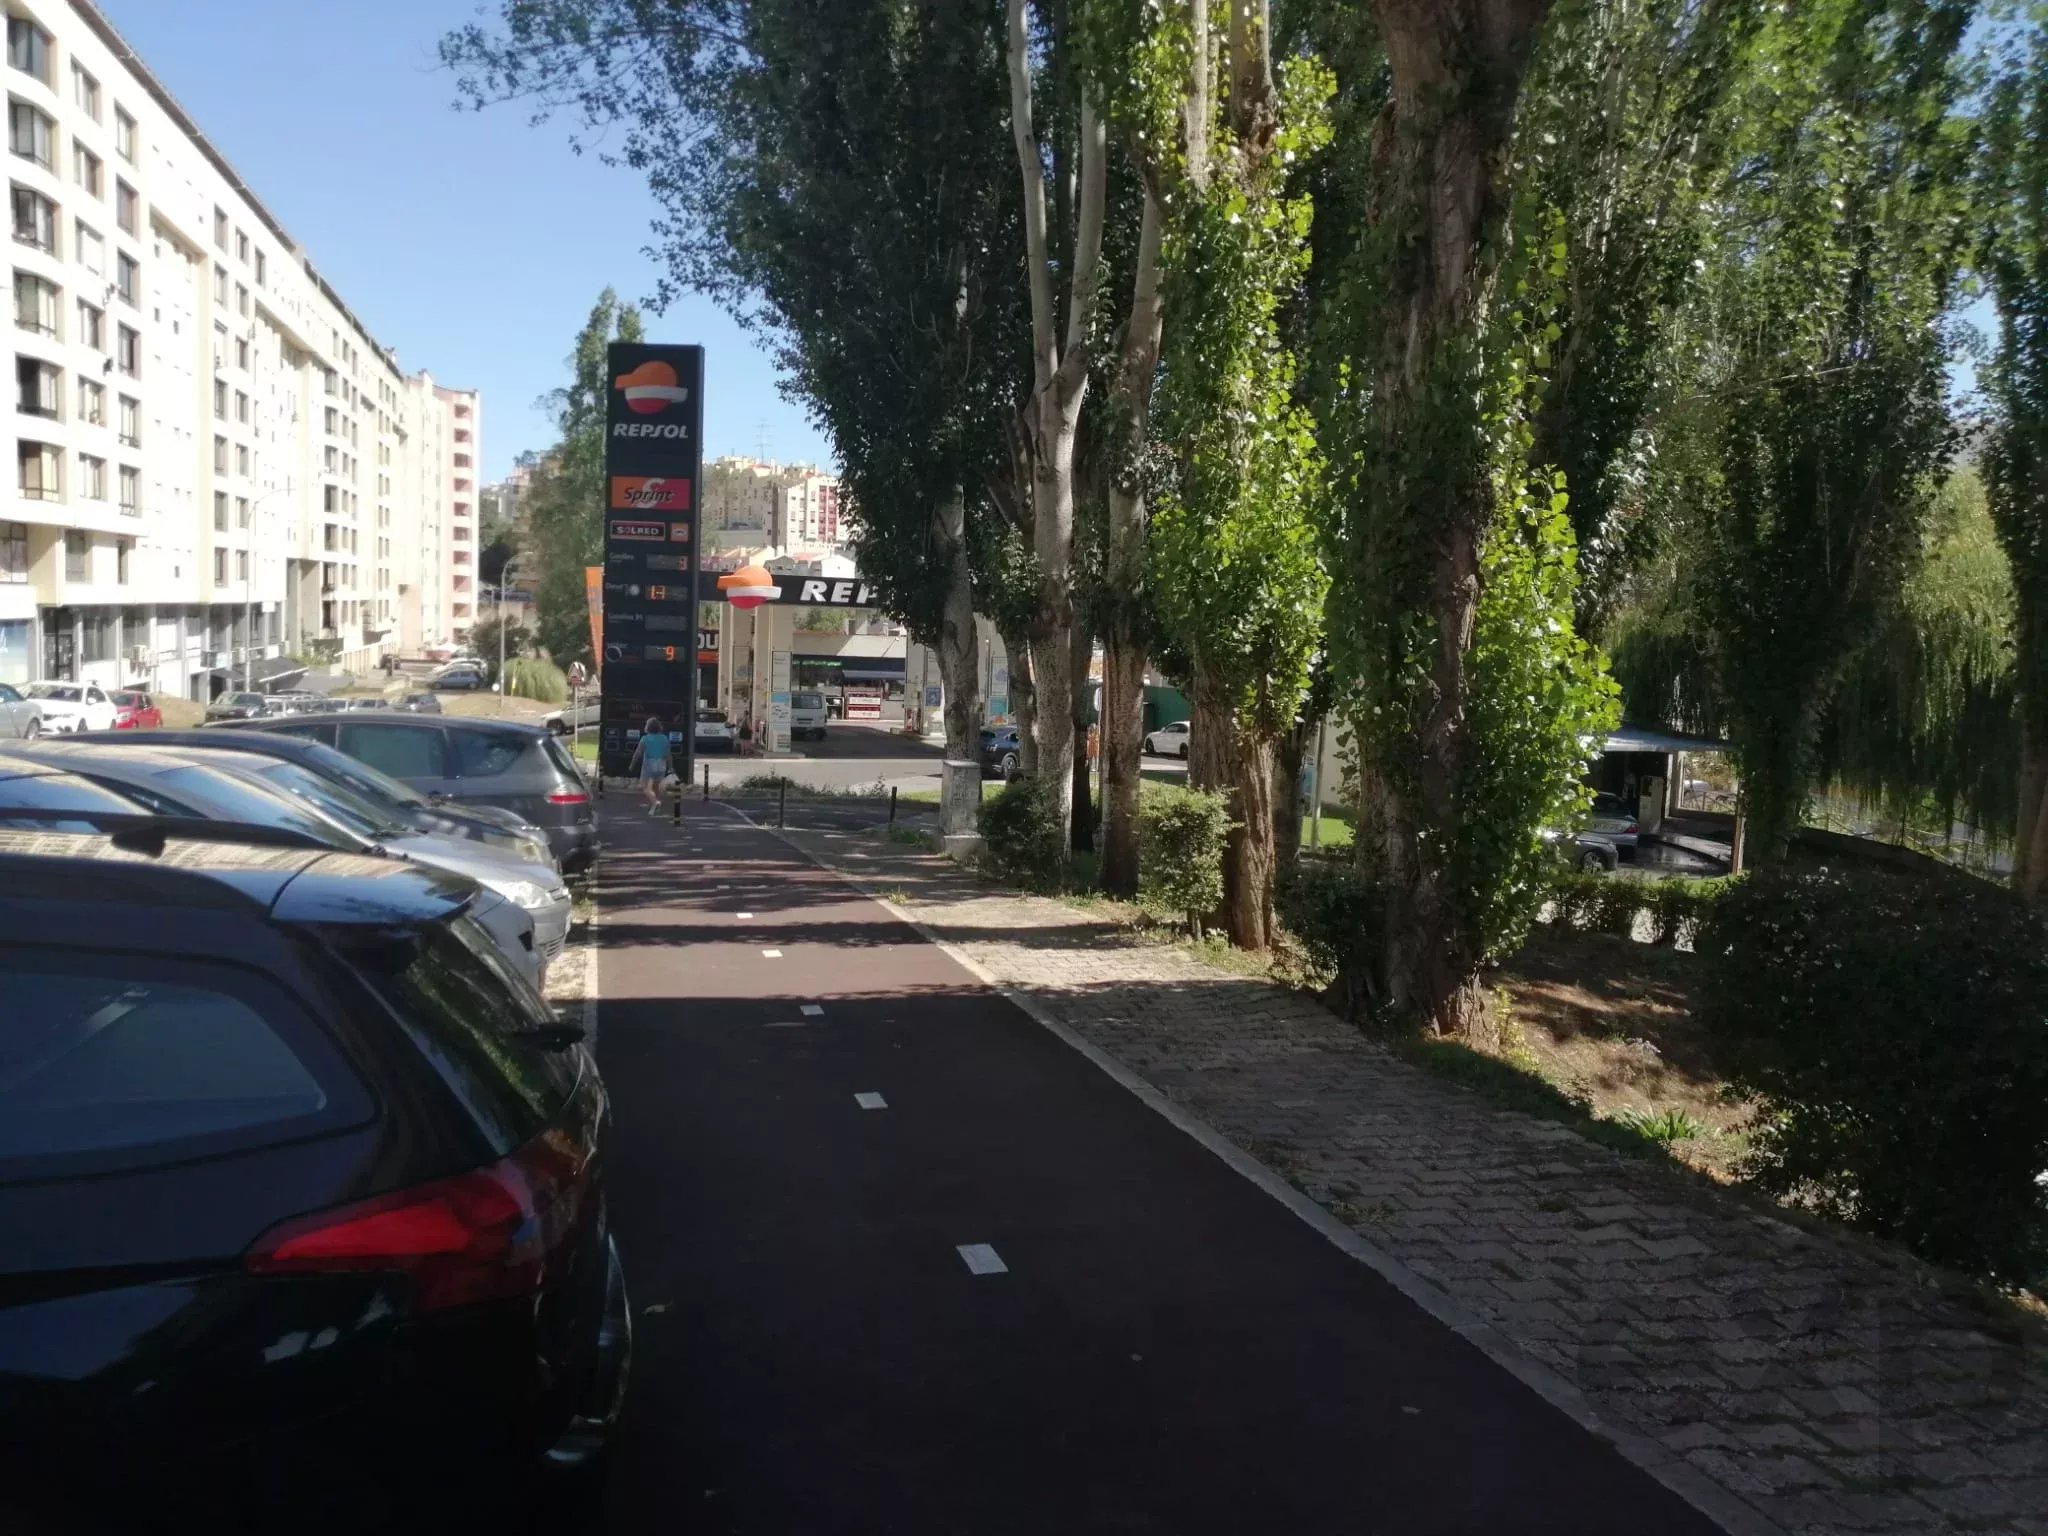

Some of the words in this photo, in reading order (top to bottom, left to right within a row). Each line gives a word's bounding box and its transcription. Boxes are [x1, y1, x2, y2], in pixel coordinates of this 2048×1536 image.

[613, 423, 688, 438] REPSOL
[624, 487, 674, 503] Sprint
[616, 526, 659, 535] SOLRED
